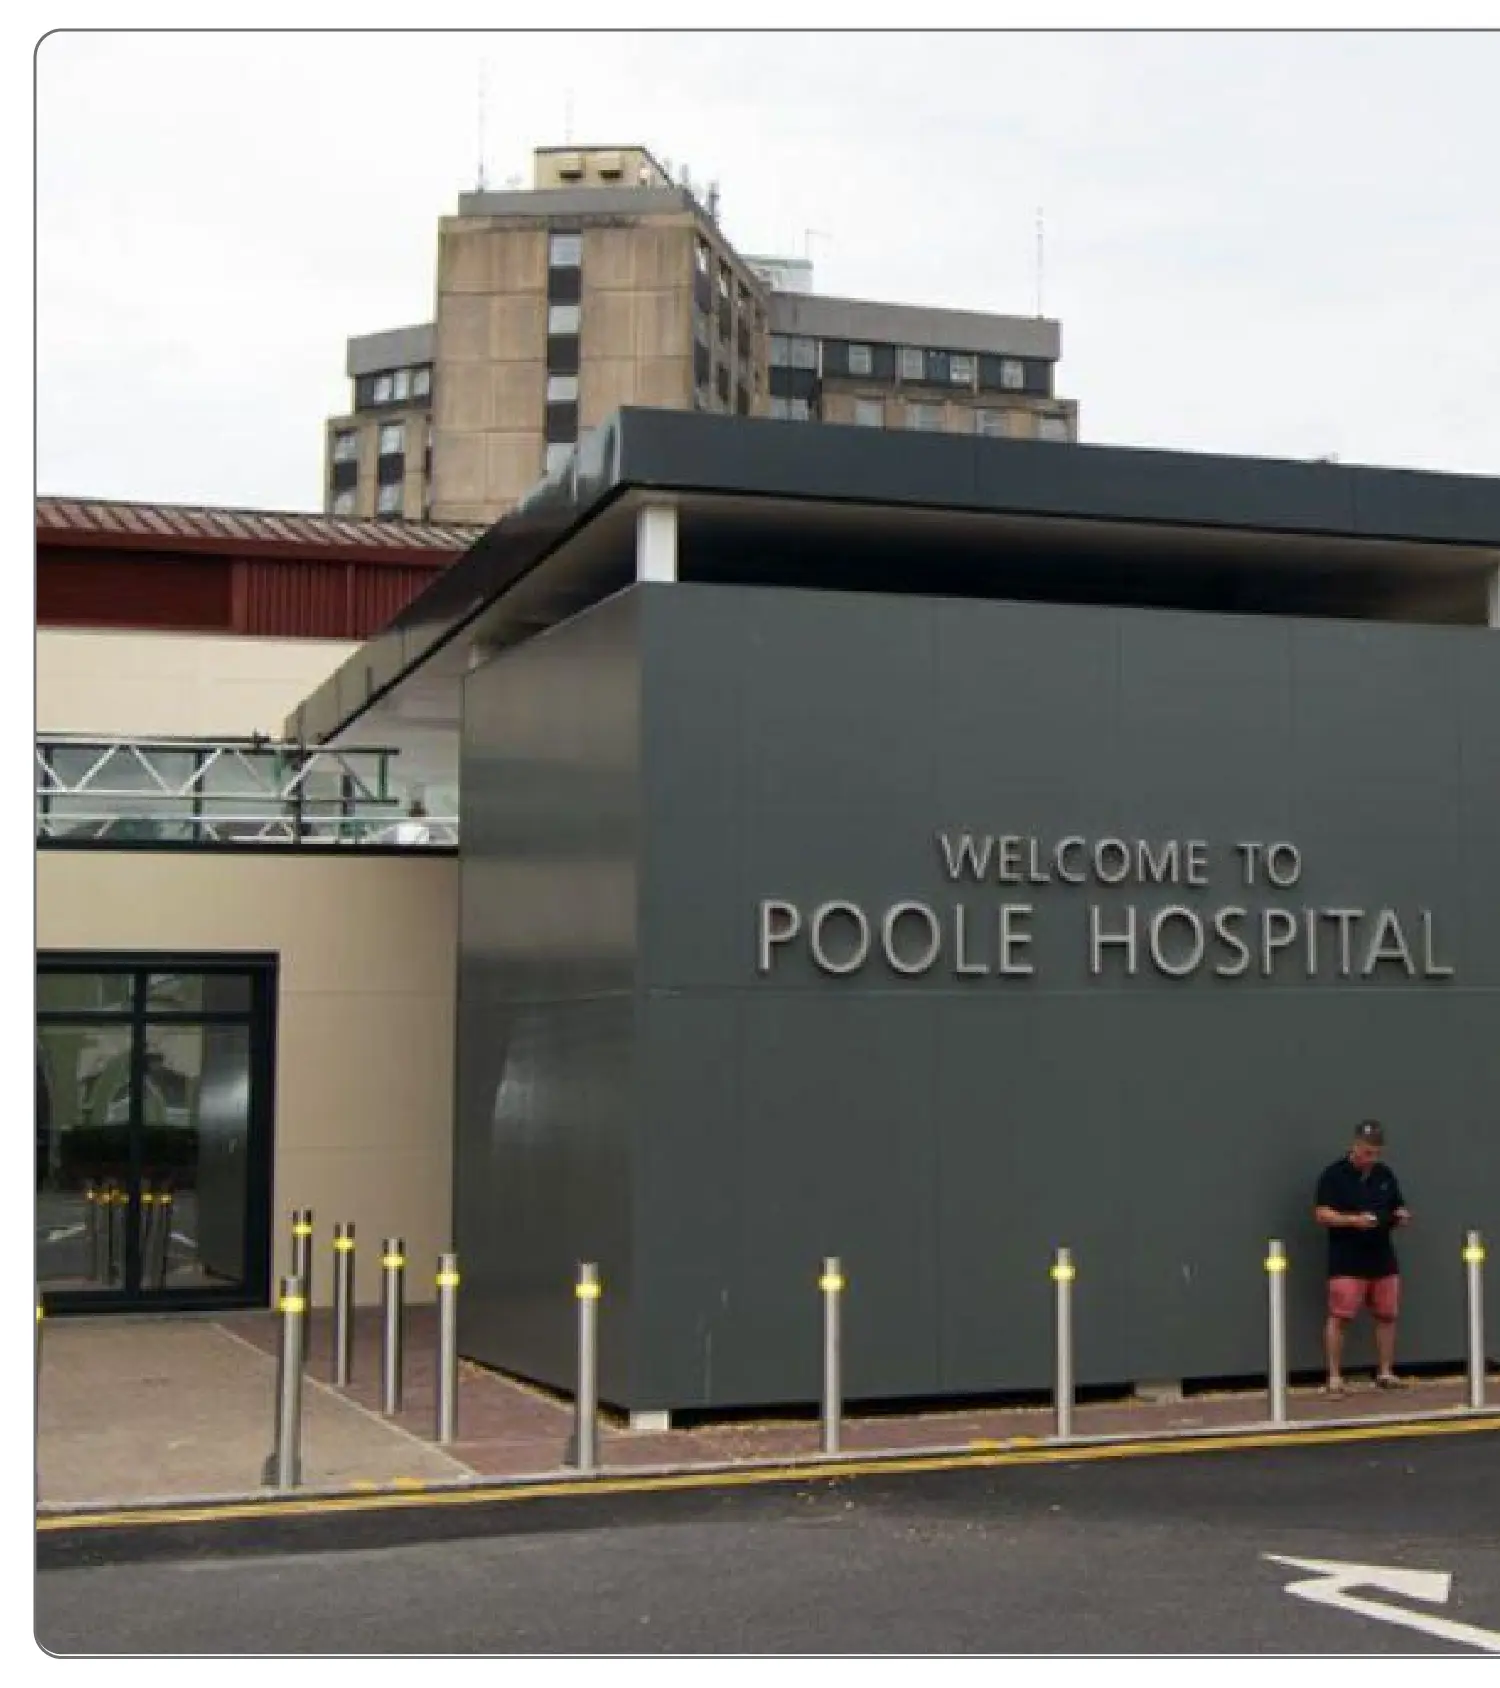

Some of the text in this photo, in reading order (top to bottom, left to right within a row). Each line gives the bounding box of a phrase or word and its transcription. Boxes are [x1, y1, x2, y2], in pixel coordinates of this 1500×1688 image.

[939, 833, 1303, 886] WELCOME TO
[758, 900, 1456, 978] POOLE HOSPITAL
